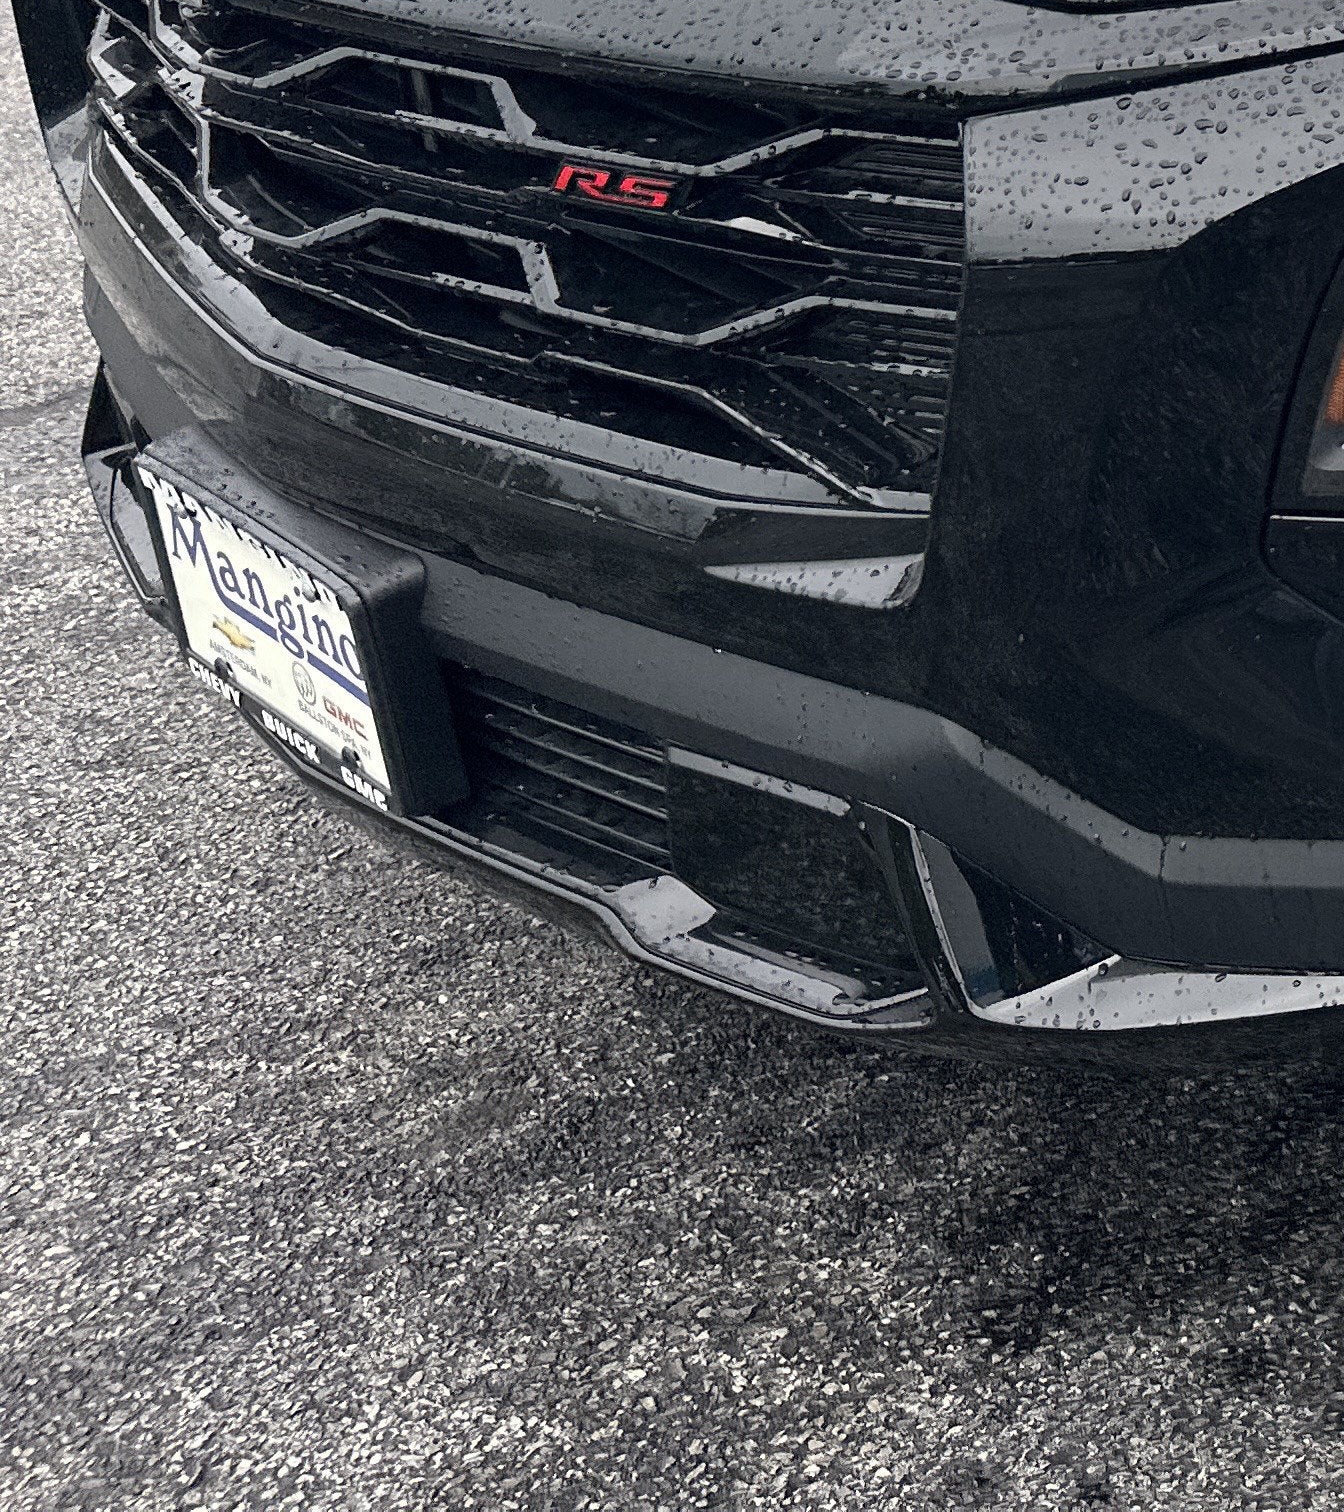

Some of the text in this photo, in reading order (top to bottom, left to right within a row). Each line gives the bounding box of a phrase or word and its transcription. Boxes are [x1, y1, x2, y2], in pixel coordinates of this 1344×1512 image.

[553, 164, 676, 208] RS
[166, 503, 364, 680] Mangino
[188, 657, 241, 708] CHEVY
[262, 710, 320, 765] BUICK
[322, 694, 369, 742] GMC
[341, 765, 388, 812] GMC
